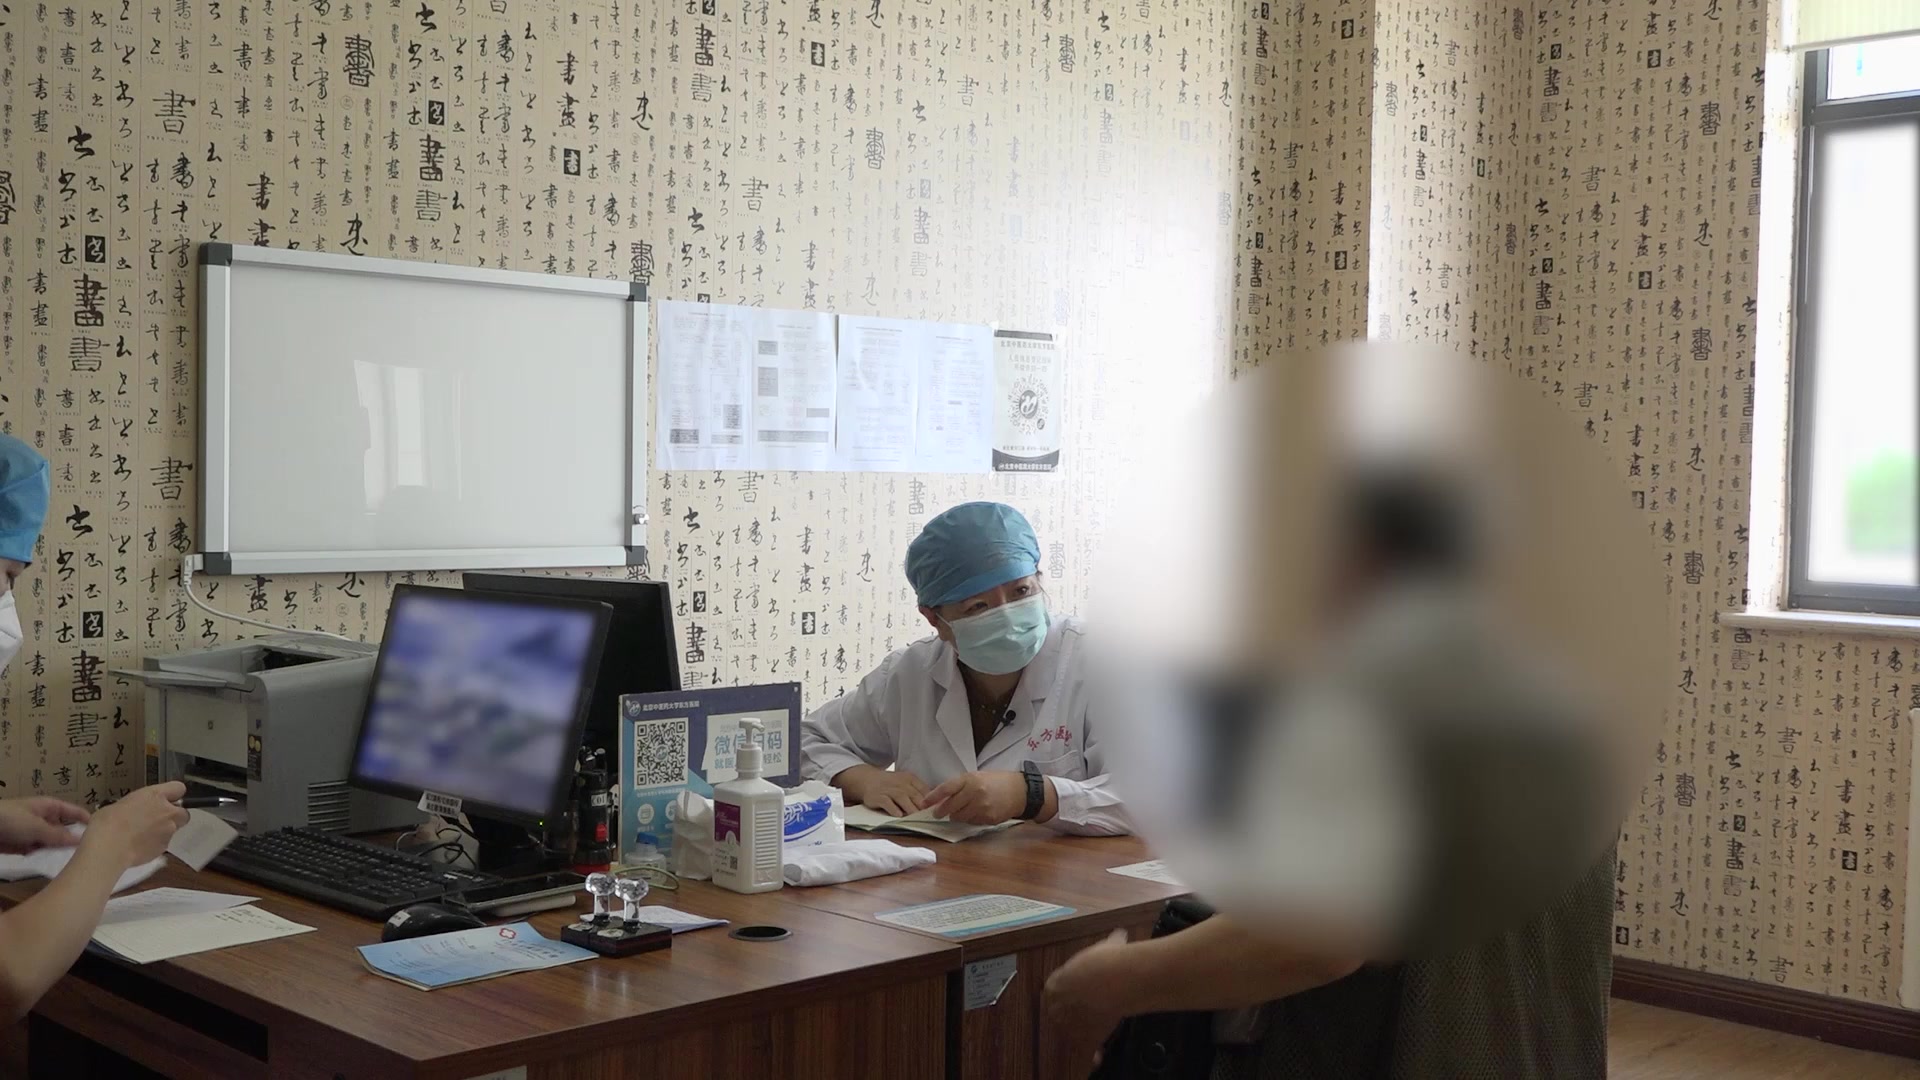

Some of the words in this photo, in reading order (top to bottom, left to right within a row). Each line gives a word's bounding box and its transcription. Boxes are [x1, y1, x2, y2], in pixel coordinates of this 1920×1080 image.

[1445, 39, 1460, 66] 書
[957, 74, 979, 107] 書
[153, 89, 196, 134] 書
[1284, 142, 1303, 168] 書
[1581, 165, 1606, 191] 書
[741, 176, 769, 212] 書
[1438, 262, 1453, 289] 書
[1574, 382, 1598, 407] 書
[151, 457, 193, 500] 書
[737, 471, 764, 503] 書
[1777, 727, 1802, 754] 書
[1769, 956, 1794, 983] 書
